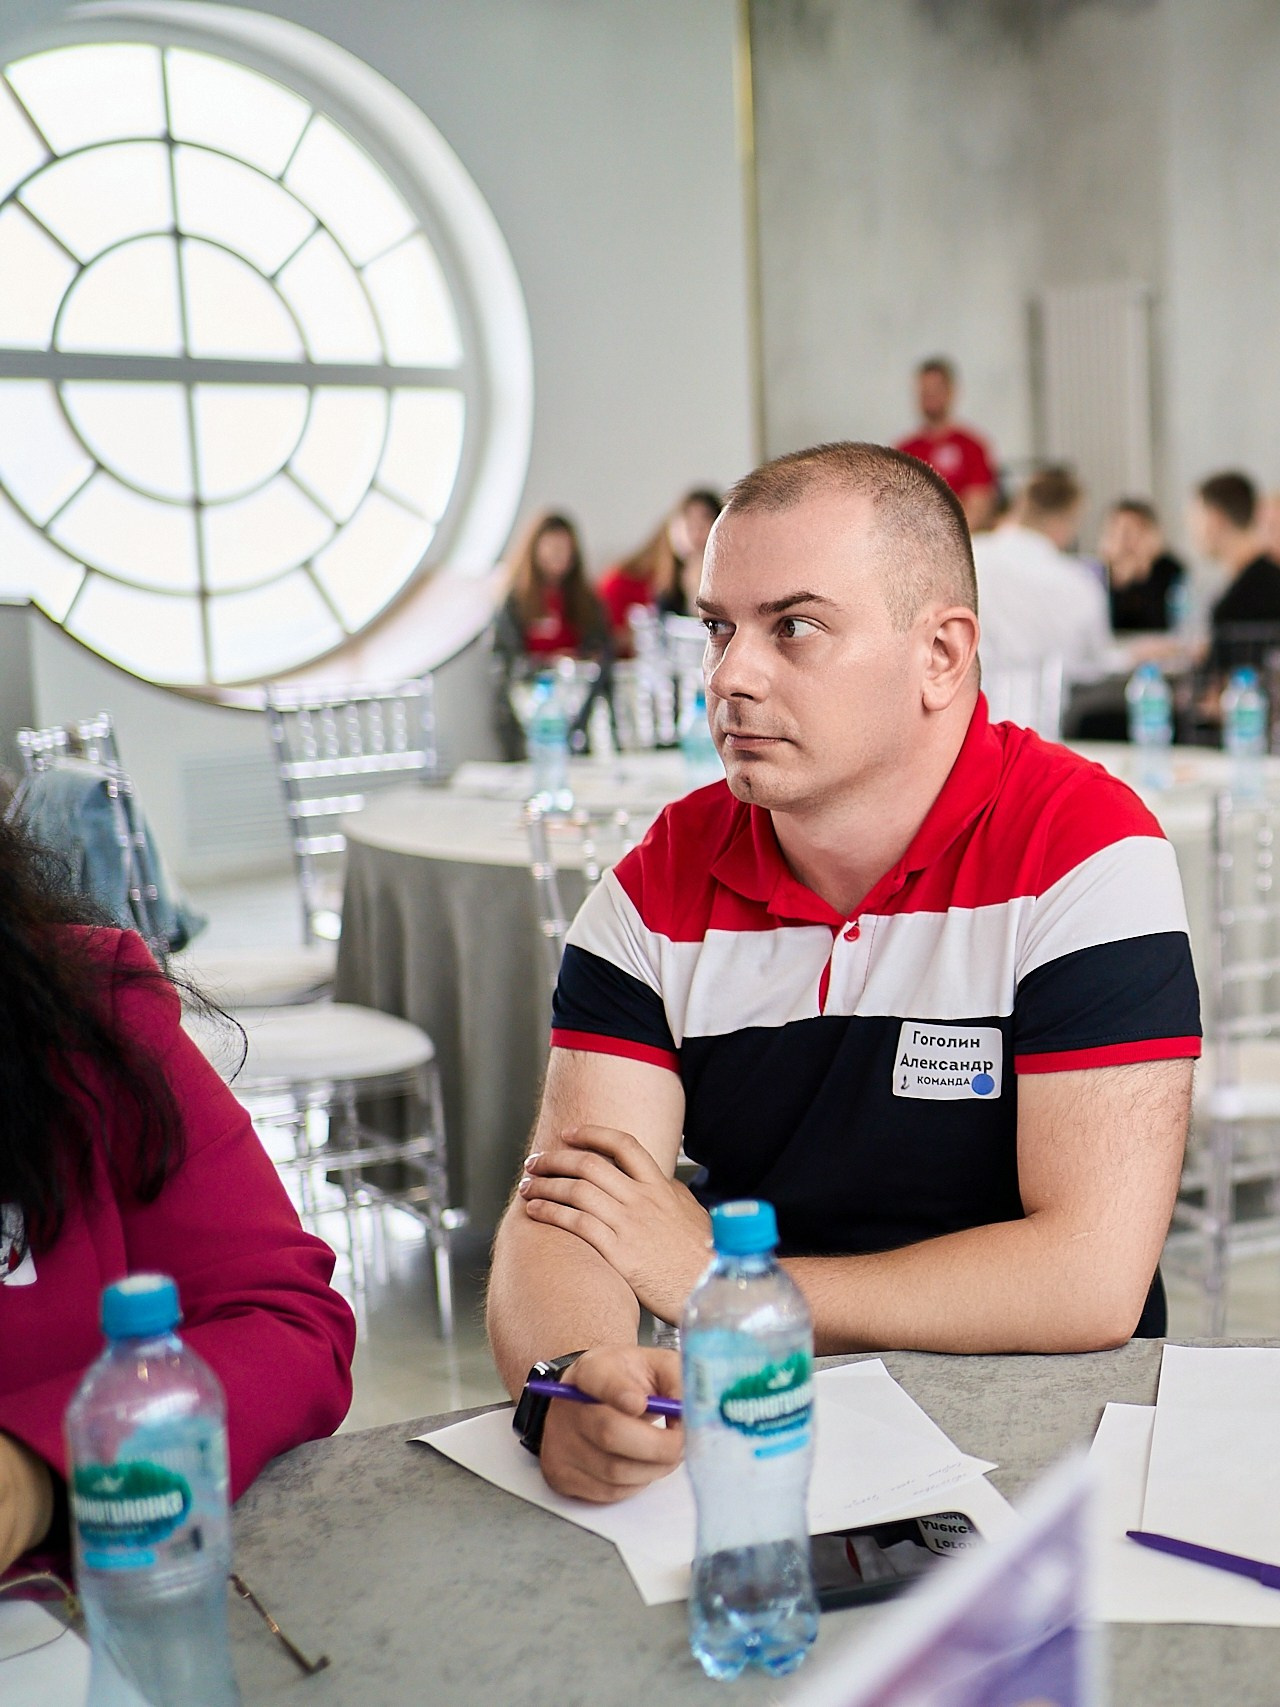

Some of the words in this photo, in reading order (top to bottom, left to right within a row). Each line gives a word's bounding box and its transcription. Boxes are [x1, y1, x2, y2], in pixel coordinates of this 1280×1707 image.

[913, 1030, 980, 1048] Гоголин
[900, 1053, 994, 1074] Александр
[917, 1075, 971, 1087] КОМАНДА
